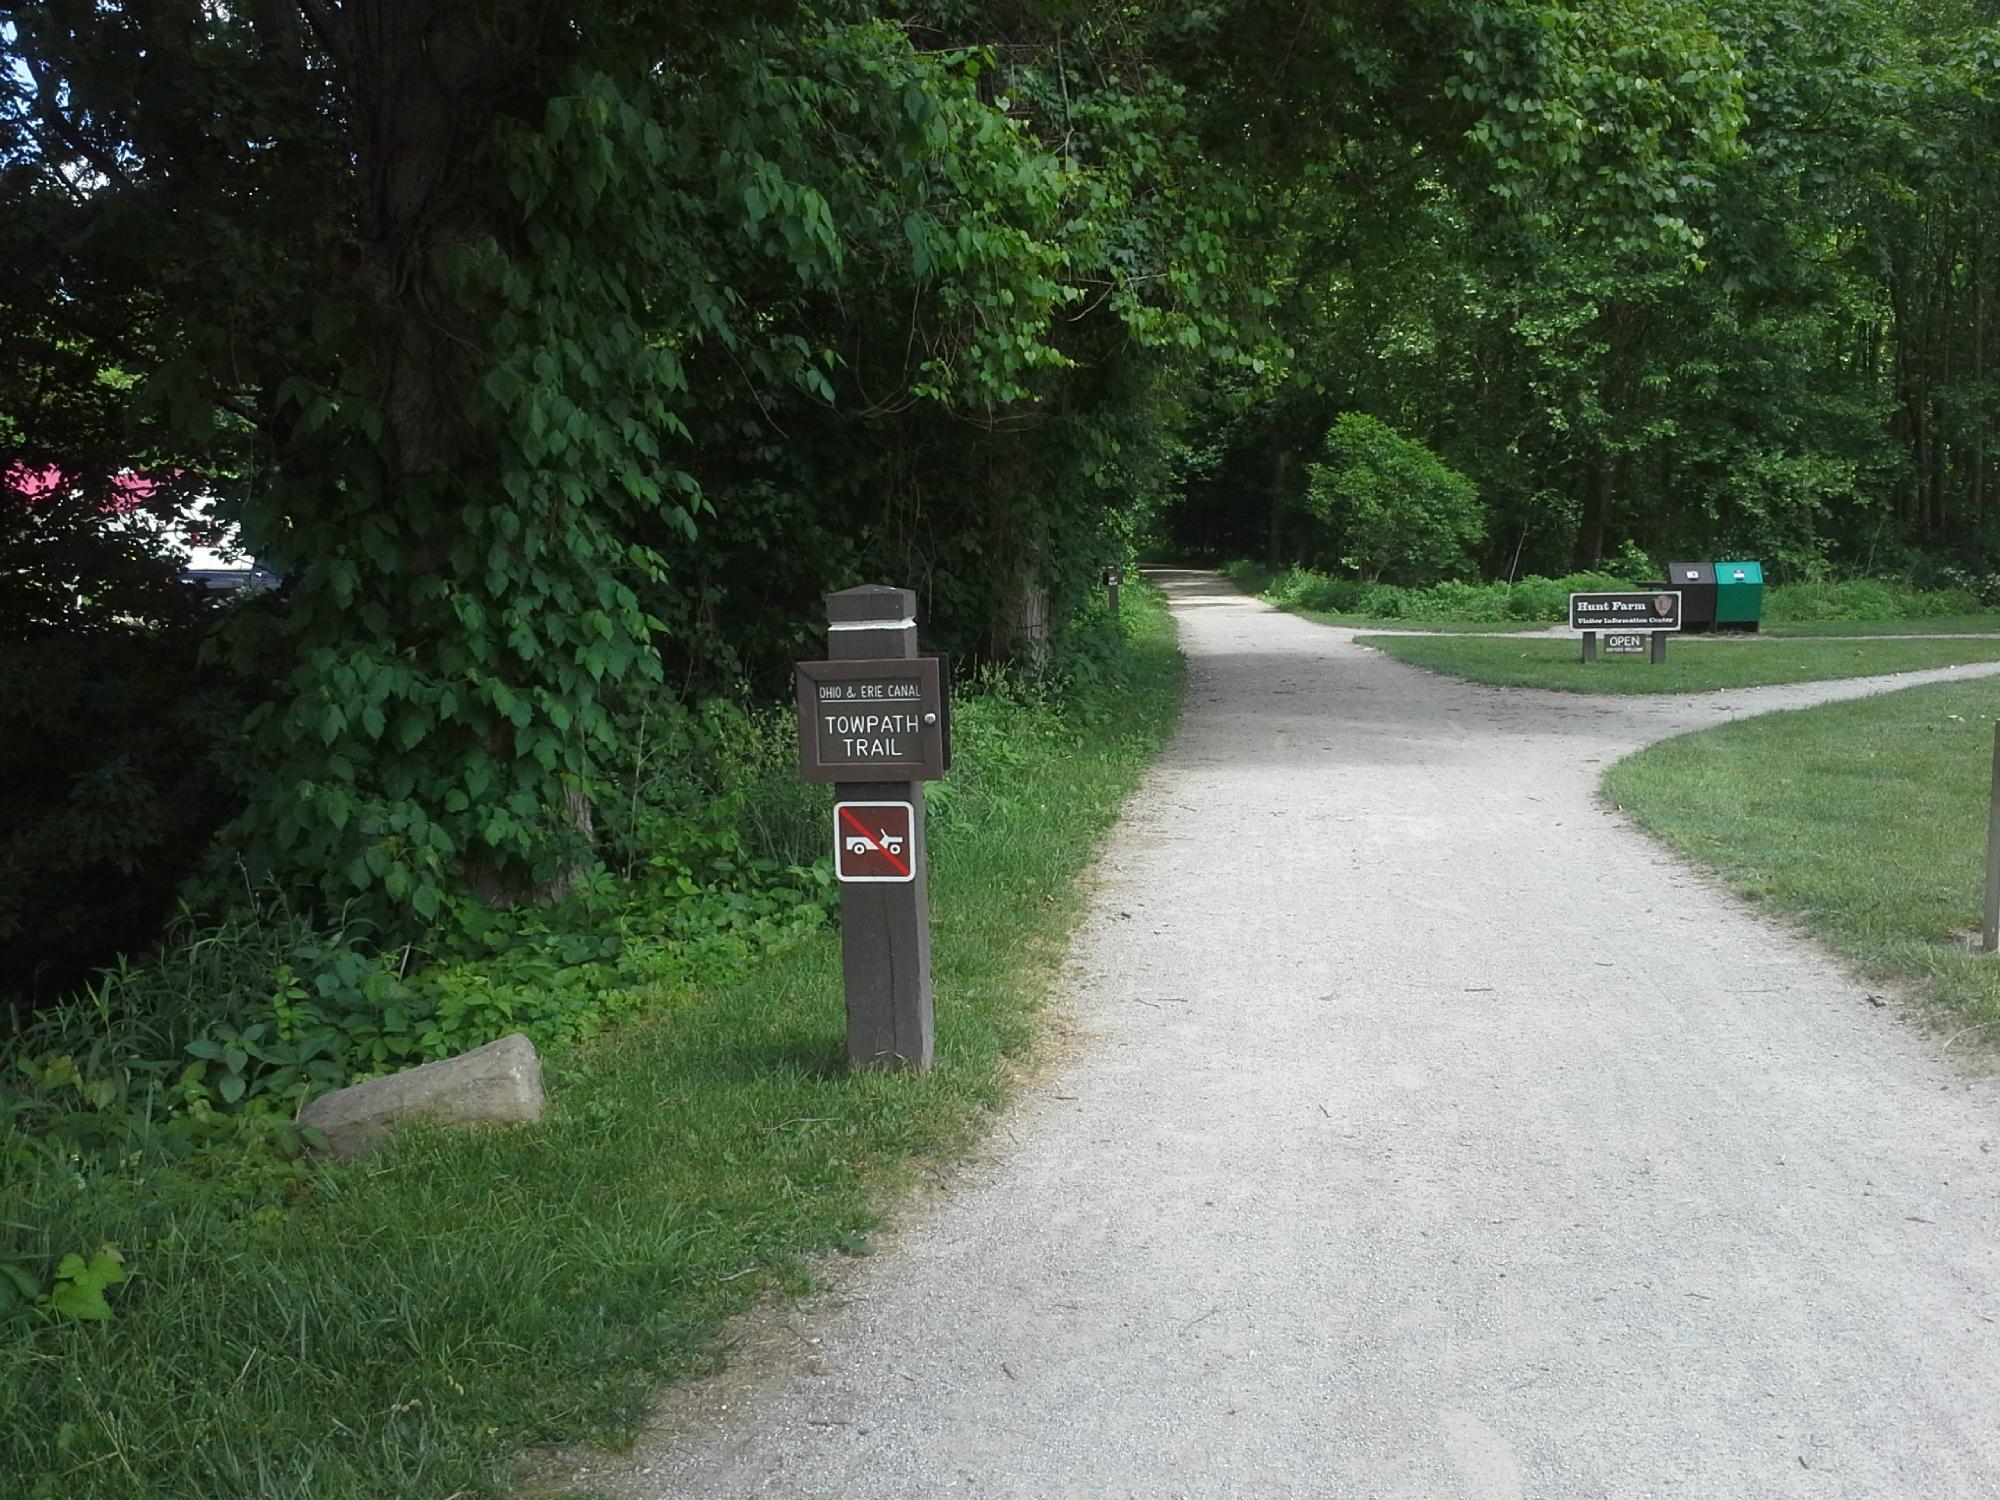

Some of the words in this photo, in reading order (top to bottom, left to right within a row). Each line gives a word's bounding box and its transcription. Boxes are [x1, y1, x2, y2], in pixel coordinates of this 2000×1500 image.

[1577, 602, 1610, 611] Hunt
[1612, 602, 1646, 611] Farm
[1609, 636, 1640, 646] OPEN
[819, 686, 842, 698] OHIO
[846, 686, 856, 698] &
[861, 685, 883, 697] ERIE
[888, 684, 921, 697] CANAL
[825, 715, 919, 734] TOWPATH
[843, 738, 903, 757] TRAIL
